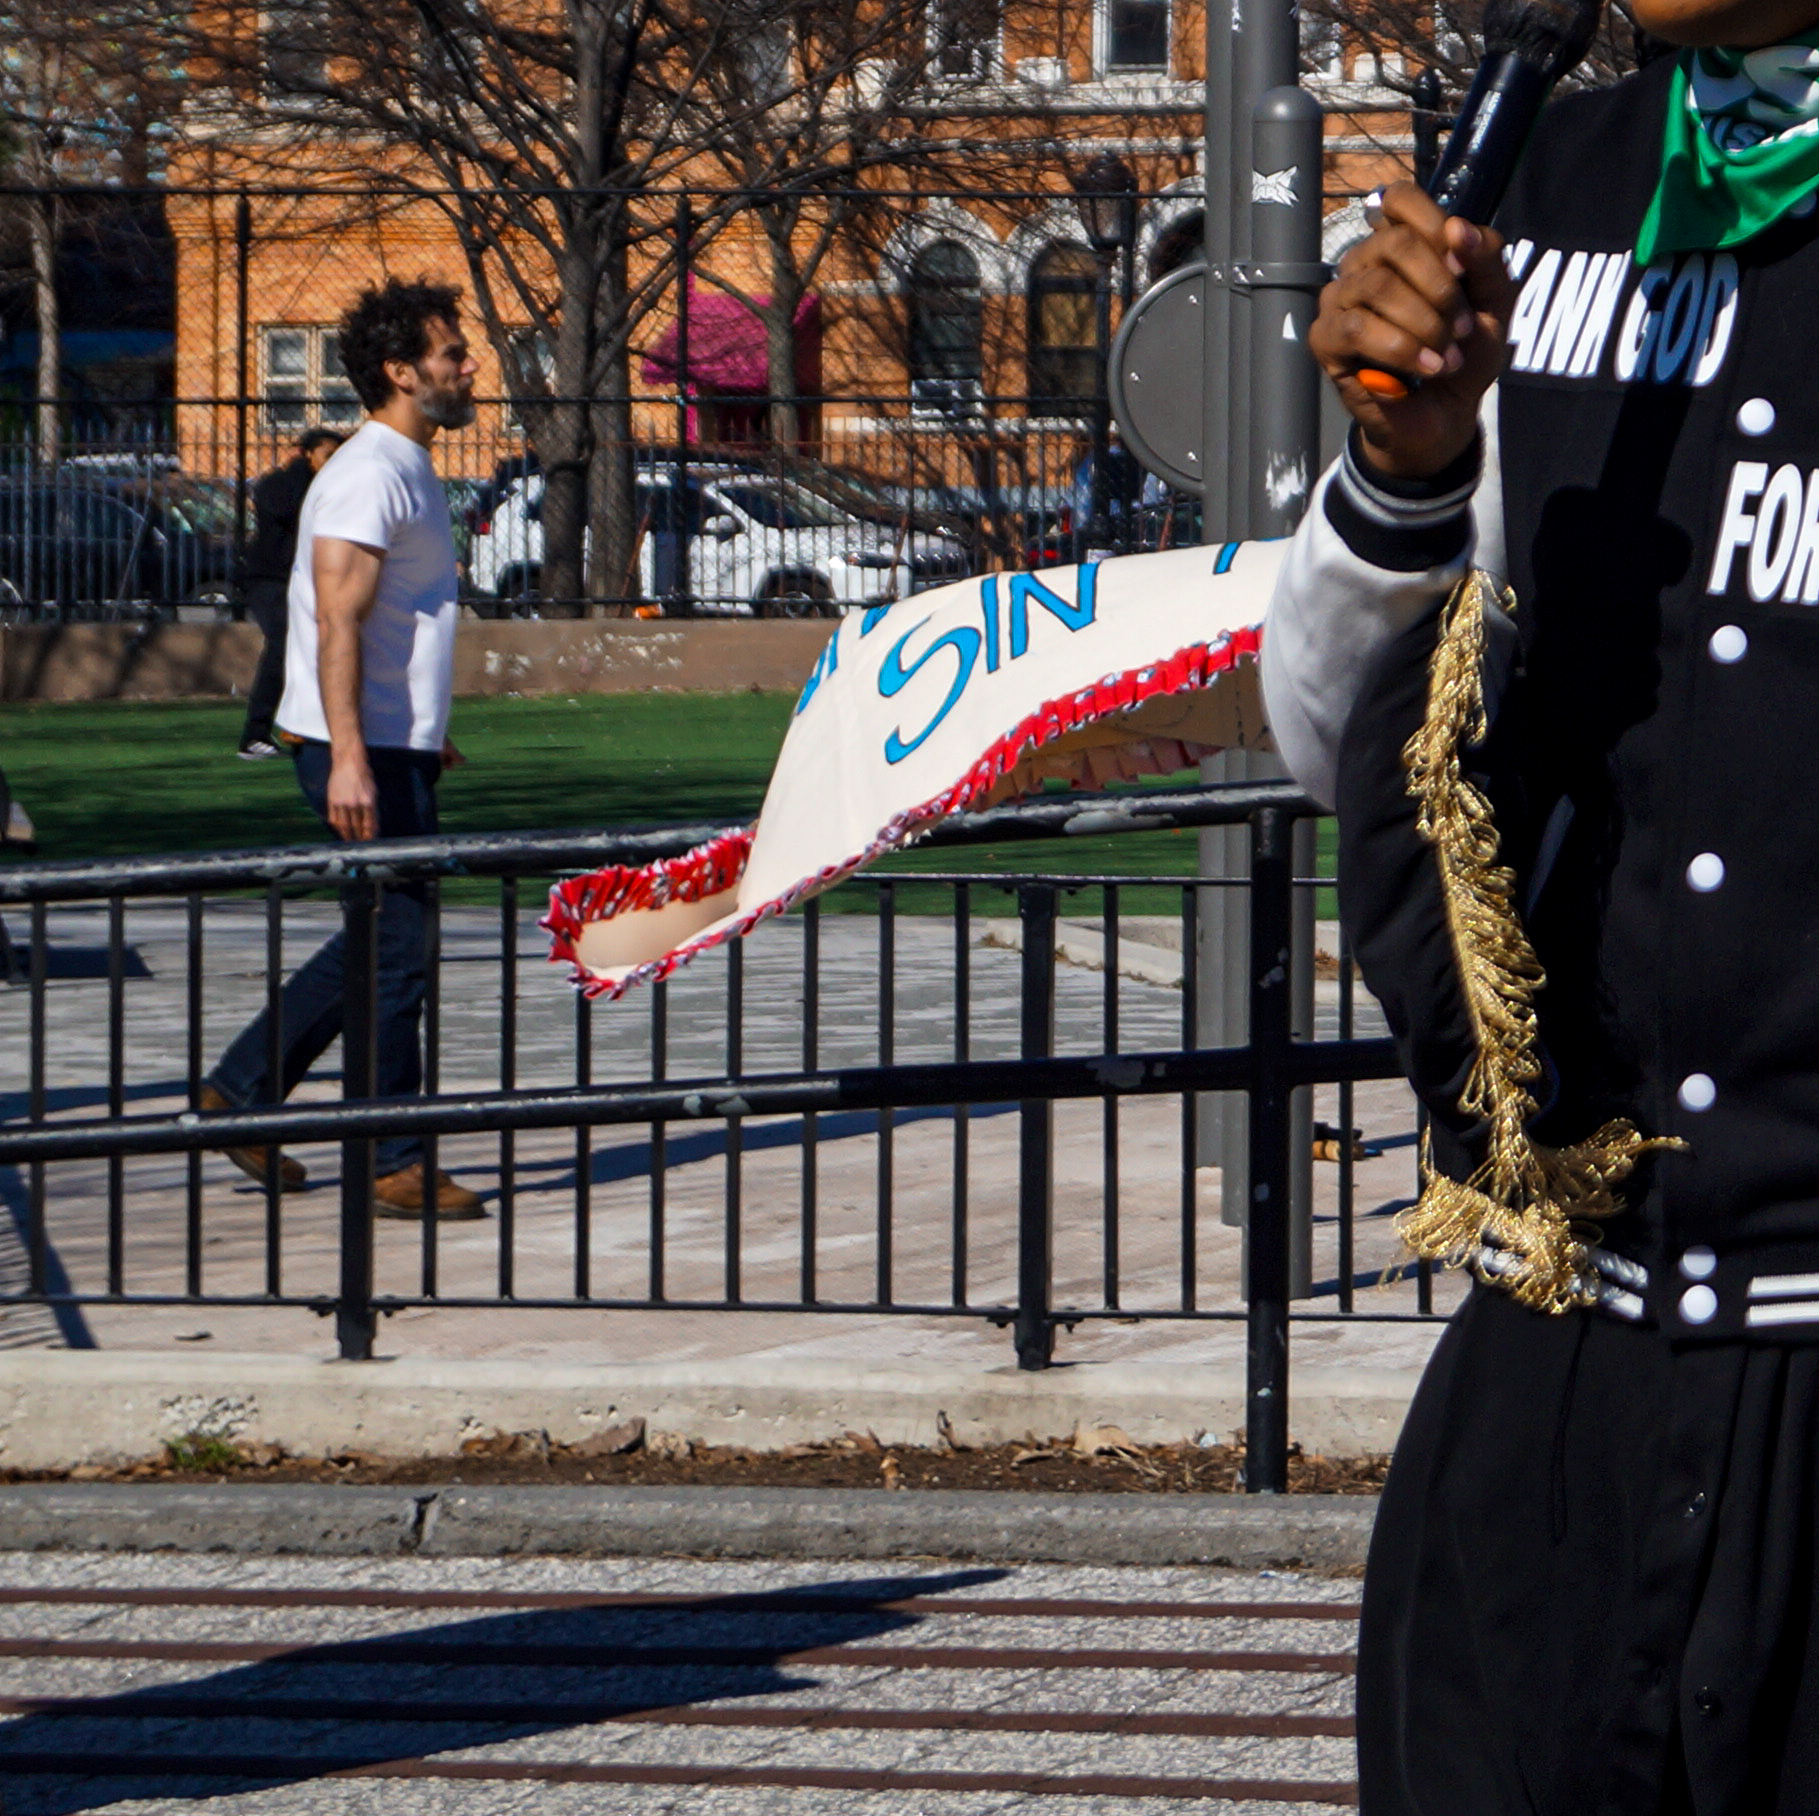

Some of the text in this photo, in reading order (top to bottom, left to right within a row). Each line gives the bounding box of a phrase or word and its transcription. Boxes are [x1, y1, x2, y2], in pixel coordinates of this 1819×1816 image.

[1502, 239, 1739, 387] ANK GOD
[877, 562, 1100, 766] SIN
